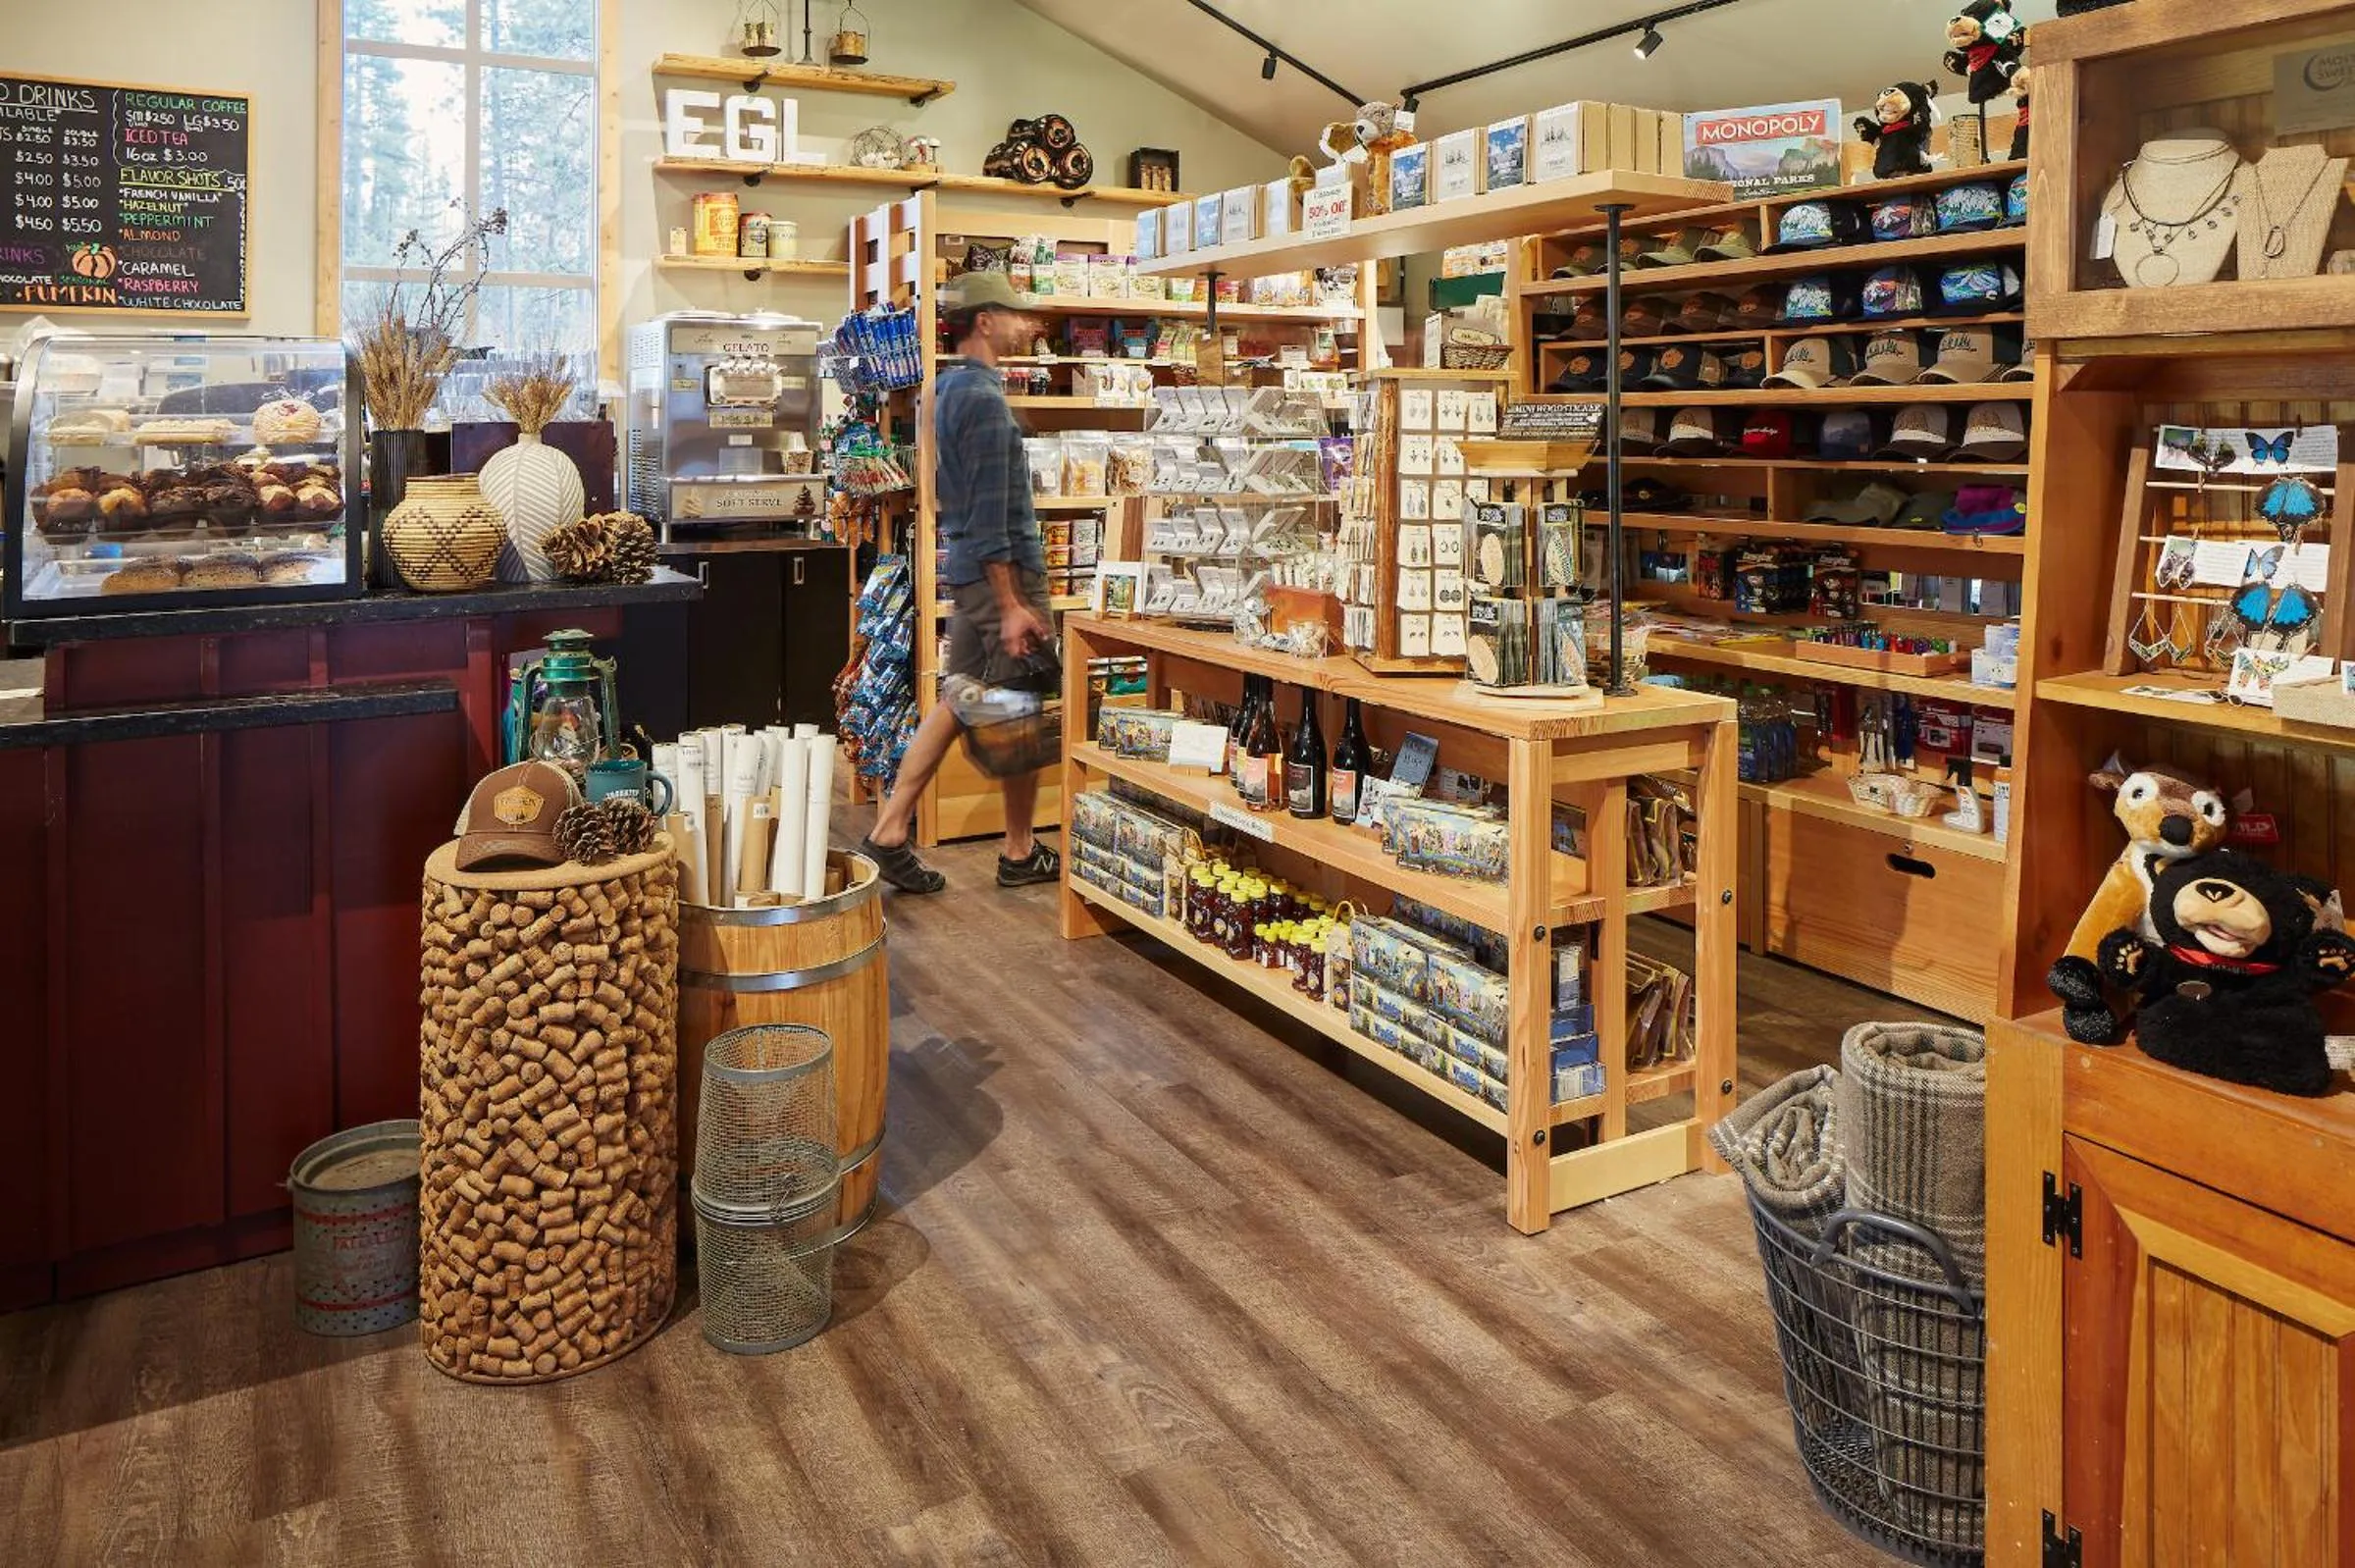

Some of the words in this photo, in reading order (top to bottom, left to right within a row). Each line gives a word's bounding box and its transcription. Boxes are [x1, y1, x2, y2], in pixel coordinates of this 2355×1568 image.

[20, 84, 95, 109] DRINKS
[125, 93, 195, 110] REGULAR
[202, 99, 246, 114] COFFEE
[665, 89, 827, 163] EGL
[1702, 115, 1820, 140] MONOPOLY
[125, 129, 157, 143] ICED
[160, 130, 188, 145] TEA
[16, 150, 53, 164] $2.50
[62, 153, 98, 167] $3.50
[15, 172, 53, 185] $4.00
[63, 173, 101, 188] $5.00
[121, 168, 174, 183] FLAVOR
[178, 171, 221, 188] SHOTS
[1732, 178, 1769, 187] IONAL
[1774, 174, 1815, 184] PARKS
[15, 194, 53, 208] $4.00
[62, 194, 98, 209] $5.00
[124, 188, 167, 199] FRENCH
[171, 190, 219, 202] VANILLA
[124, 199, 183, 213] HAZELNUT
[62, 218, 102, 233] $5.50
[124, 213, 214, 228] PEPPERMINT
[123, 229, 182, 241] ALMOND
[122, 262, 195, 277] CARAMEL
[124, 278, 199, 292] RASPBERRY
[123, 296, 170, 307] WHITE
[174, 297, 242, 310] CHOCOLATE
[723, 342, 770, 352] GELATO
